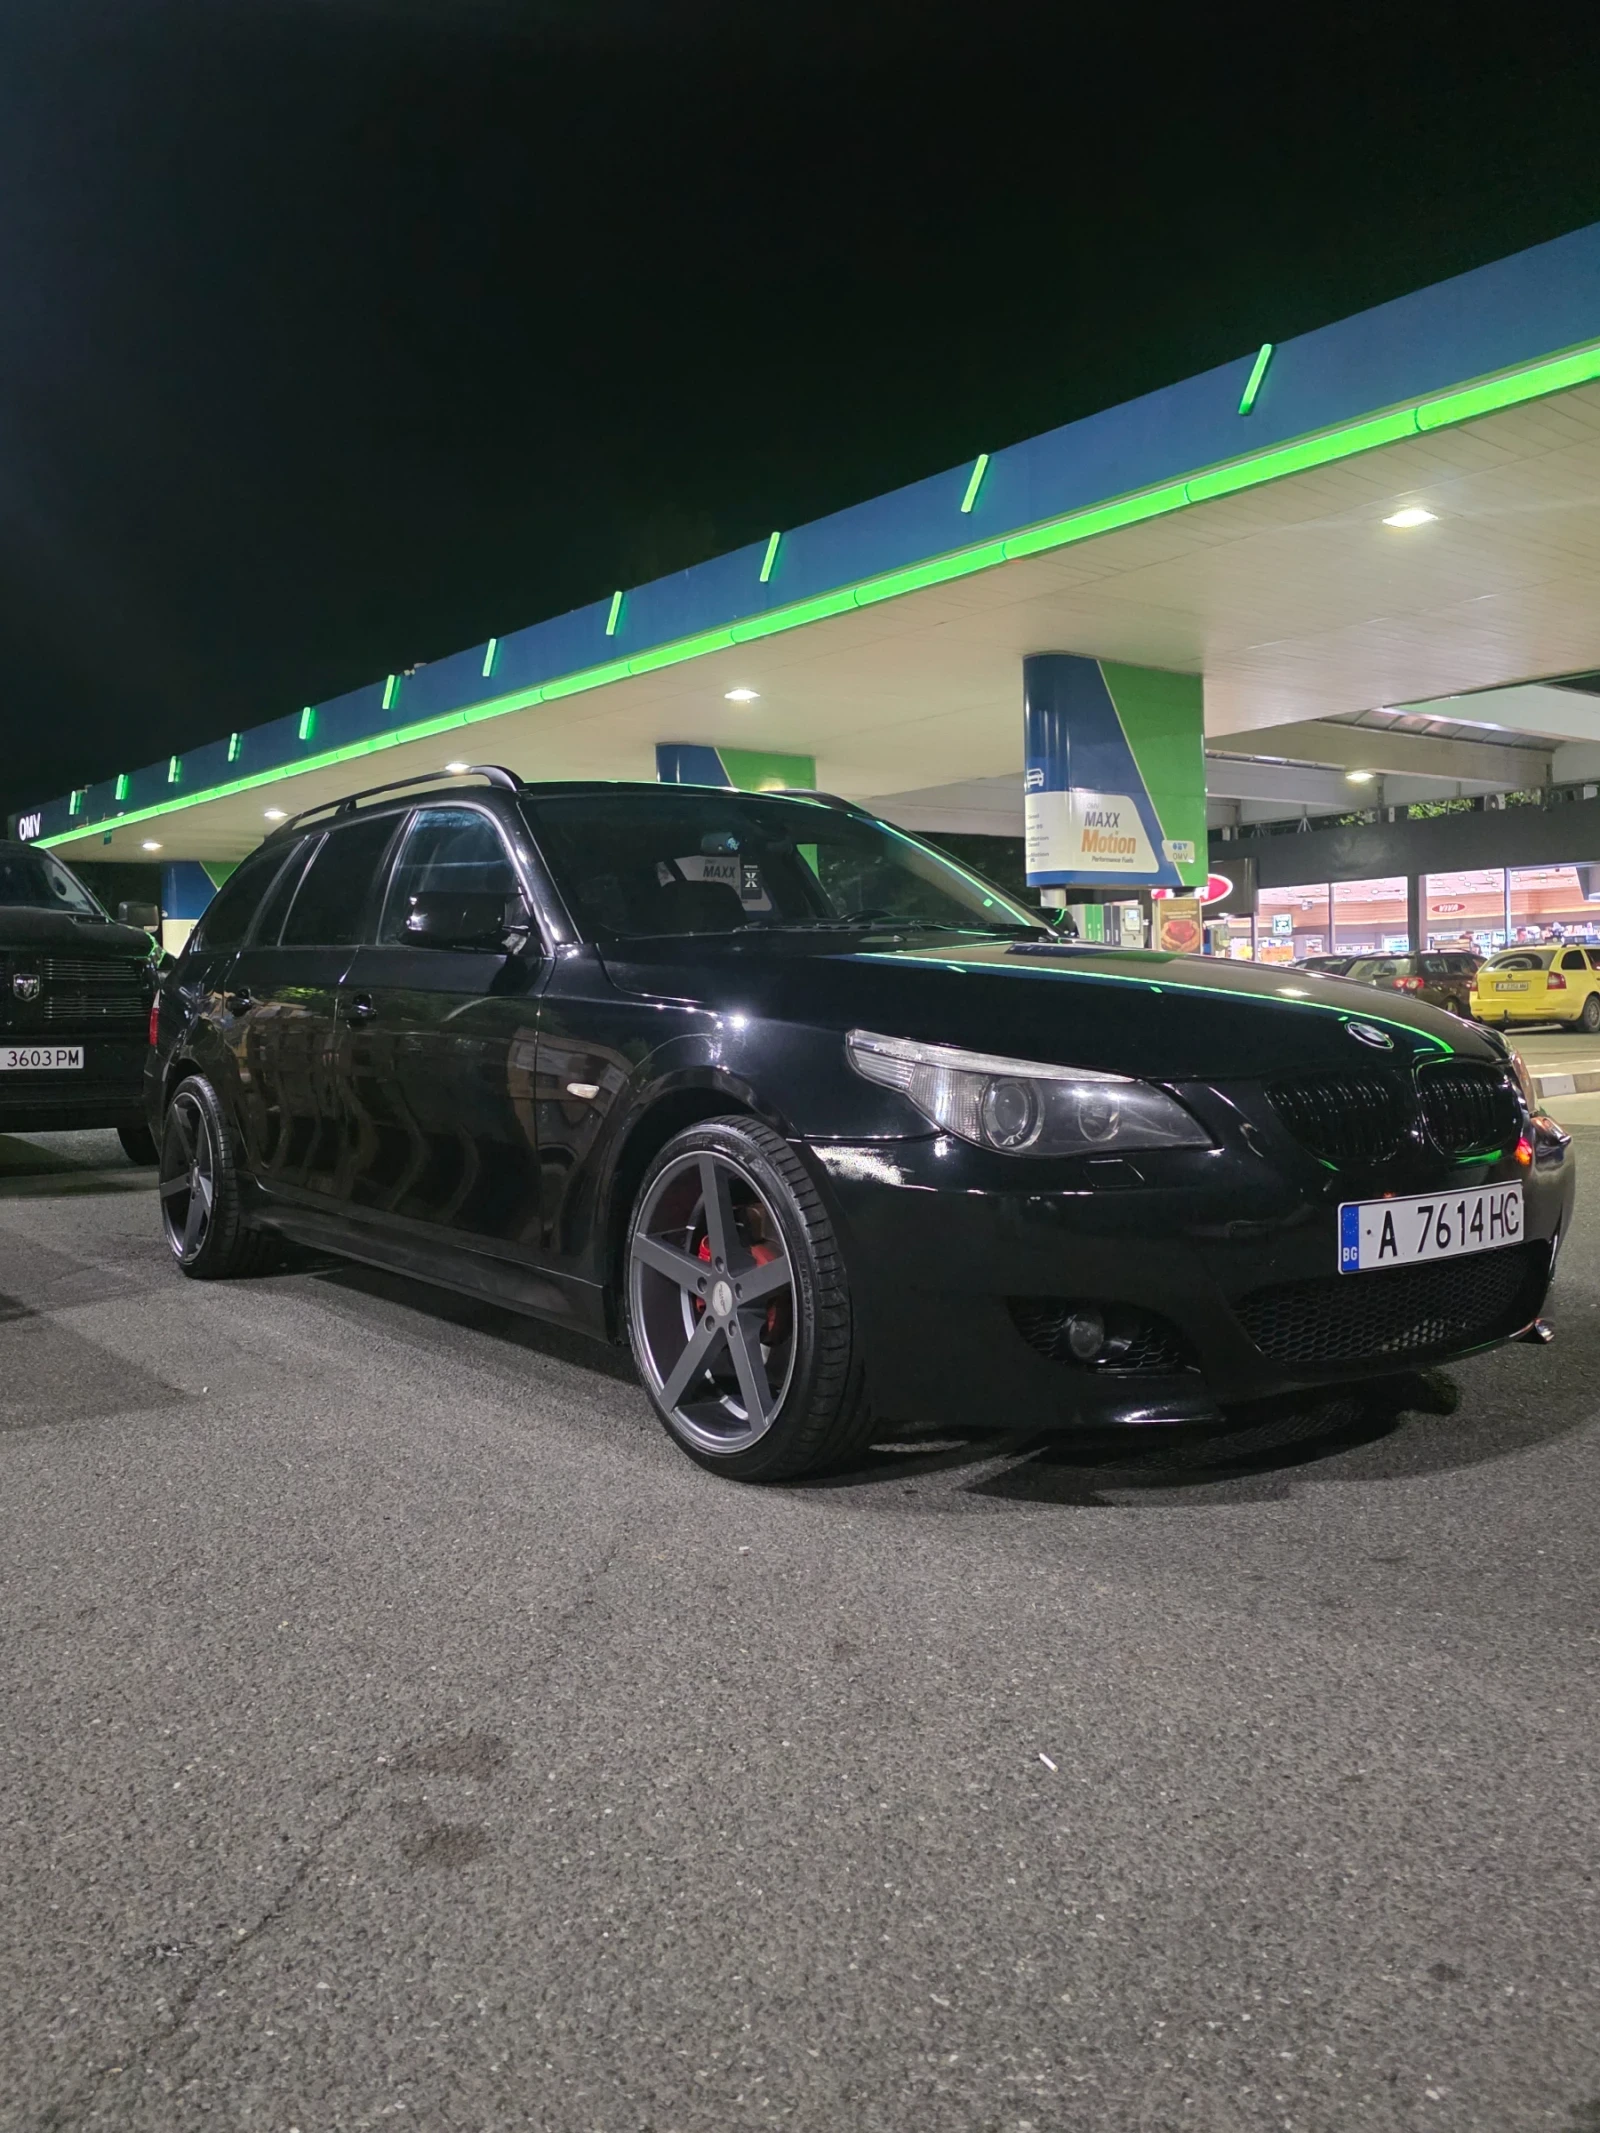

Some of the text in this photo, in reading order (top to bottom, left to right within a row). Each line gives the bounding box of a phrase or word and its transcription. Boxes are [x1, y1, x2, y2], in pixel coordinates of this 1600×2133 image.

[18, 812, 41, 841] OMV
[1084, 811, 1121, 828] MAXX
[1081, 829, 1137, 854] Motion
[1122, 856, 1134, 864] Fuels
[1172, 852, 1188, 860] OMV
[703, 865, 736, 879] MAXX
[1439, 903, 1459, 912] VIVA
[1378, 1210, 1398, 1259] A
[1343, 1246, 1358, 1262] BG
